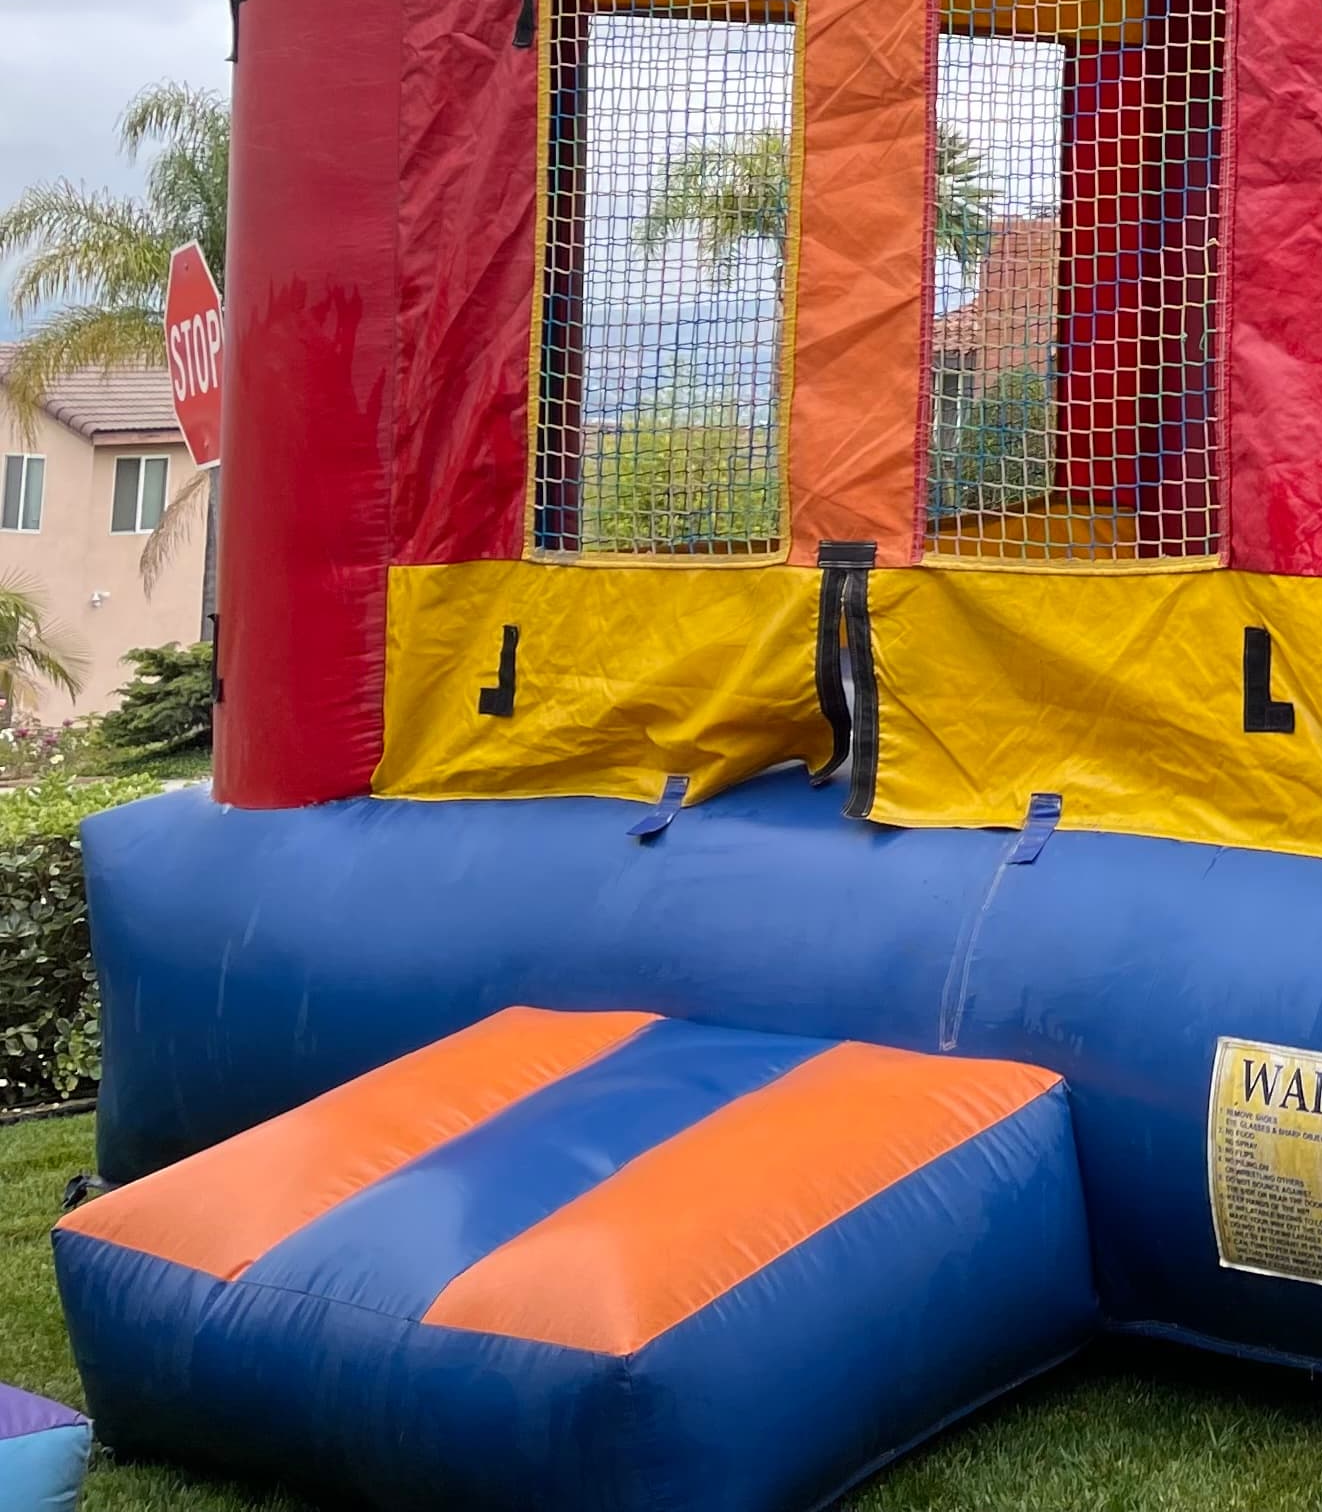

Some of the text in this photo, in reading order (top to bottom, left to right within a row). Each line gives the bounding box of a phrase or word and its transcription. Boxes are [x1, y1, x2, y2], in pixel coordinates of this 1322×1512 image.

[170, 308, 221, 402] STOP
[1227, 1109, 1253, 1119] REMOVE
[1255, 1113, 1278, 1125] SHOES
[1240, 1120, 1270, 1134] GLASSES
[1225, 1127, 1234, 1137] NO
[1235, 1129, 1255, 1140] FOOD
[1225, 1137, 1234, 1146] NO
[1225, 1146, 1234, 1156] NO
[1225, 1157, 1234, 1166] NO
[1276, 1176, 1304, 1188] OTHERS
